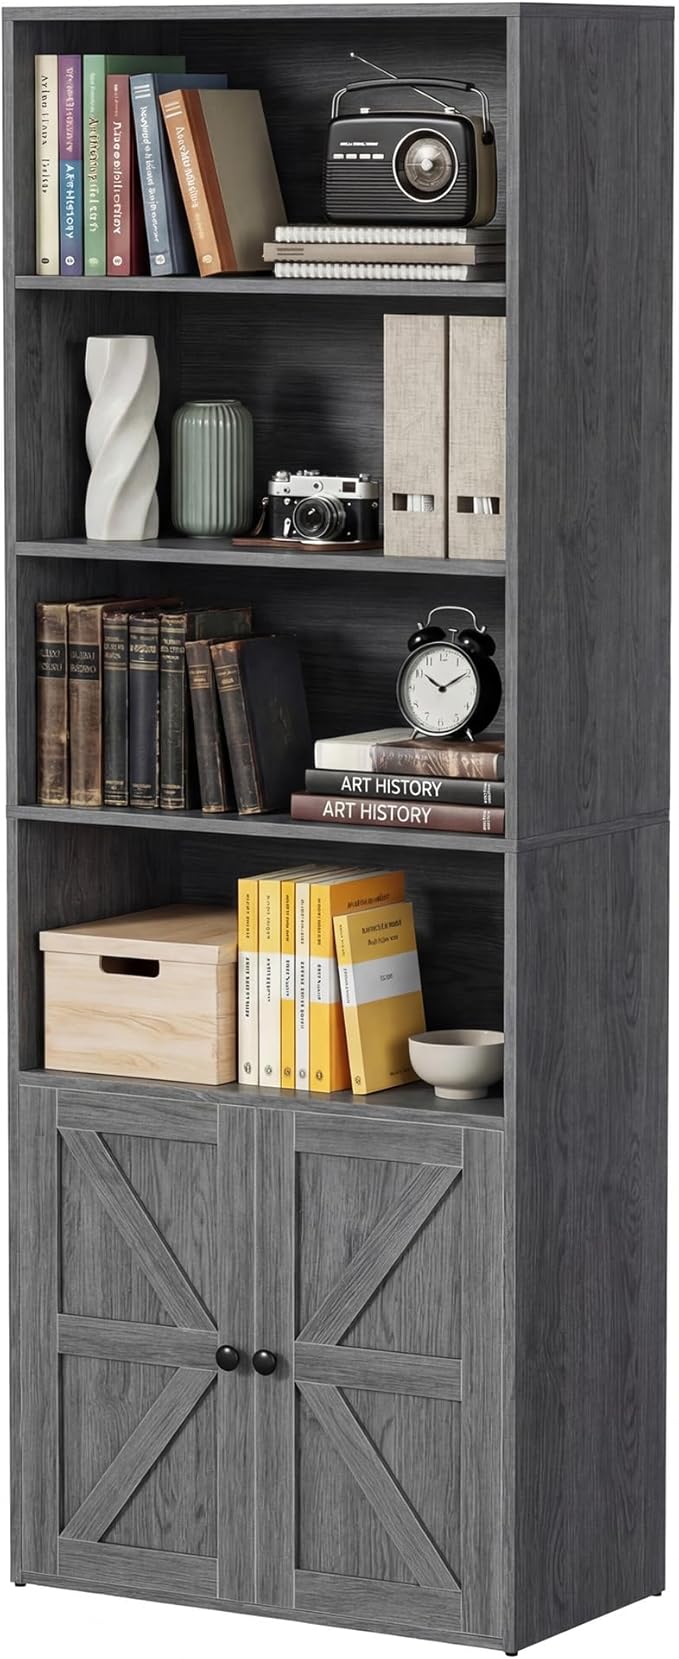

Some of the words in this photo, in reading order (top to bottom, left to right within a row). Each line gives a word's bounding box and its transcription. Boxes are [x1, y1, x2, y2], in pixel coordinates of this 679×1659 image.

[341, 776, 372, 793] ART
[375, 778, 442, 797] HISTORY
[322, 800, 356, 819] ART
[360, 802, 432, 824] HISTORY
